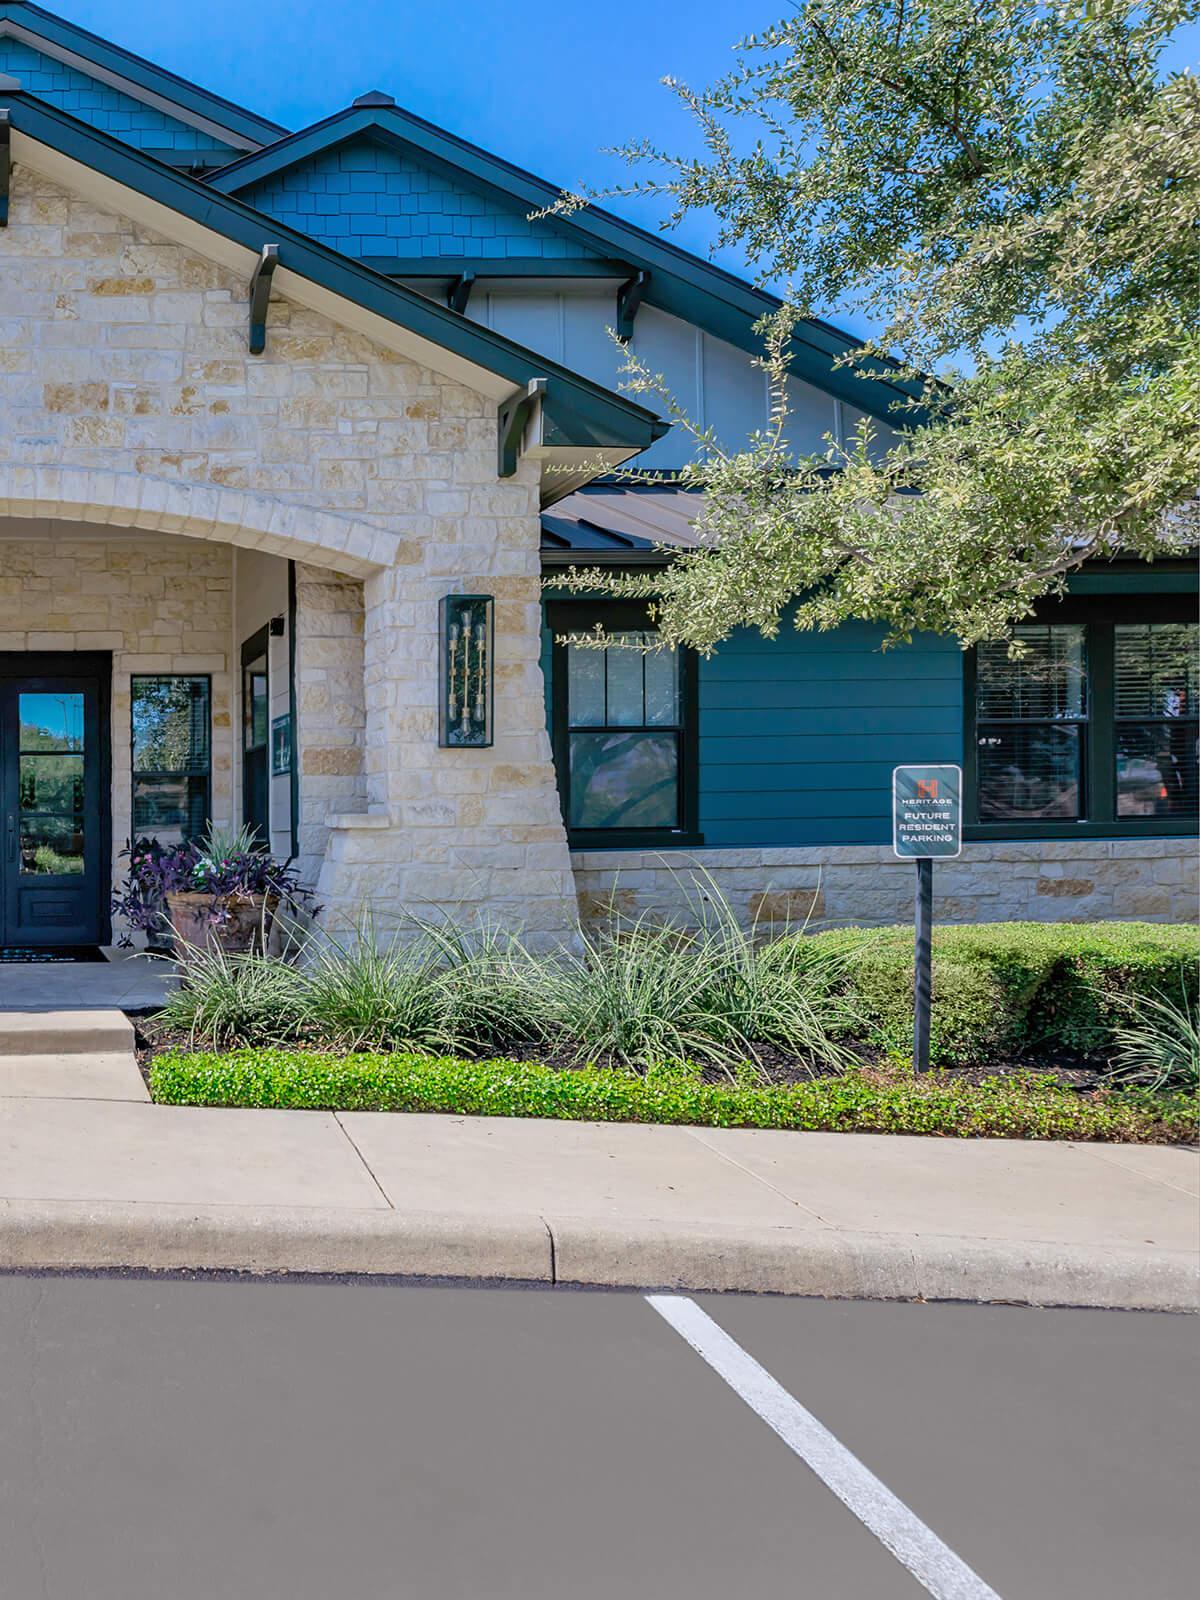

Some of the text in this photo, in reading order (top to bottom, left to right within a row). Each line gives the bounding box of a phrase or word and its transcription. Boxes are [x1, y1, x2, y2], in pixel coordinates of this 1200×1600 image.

[904, 812, 951, 820] FUTURE
[898, 823, 956, 831] RESIDENT
[902, 834, 953, 842] PARKING
